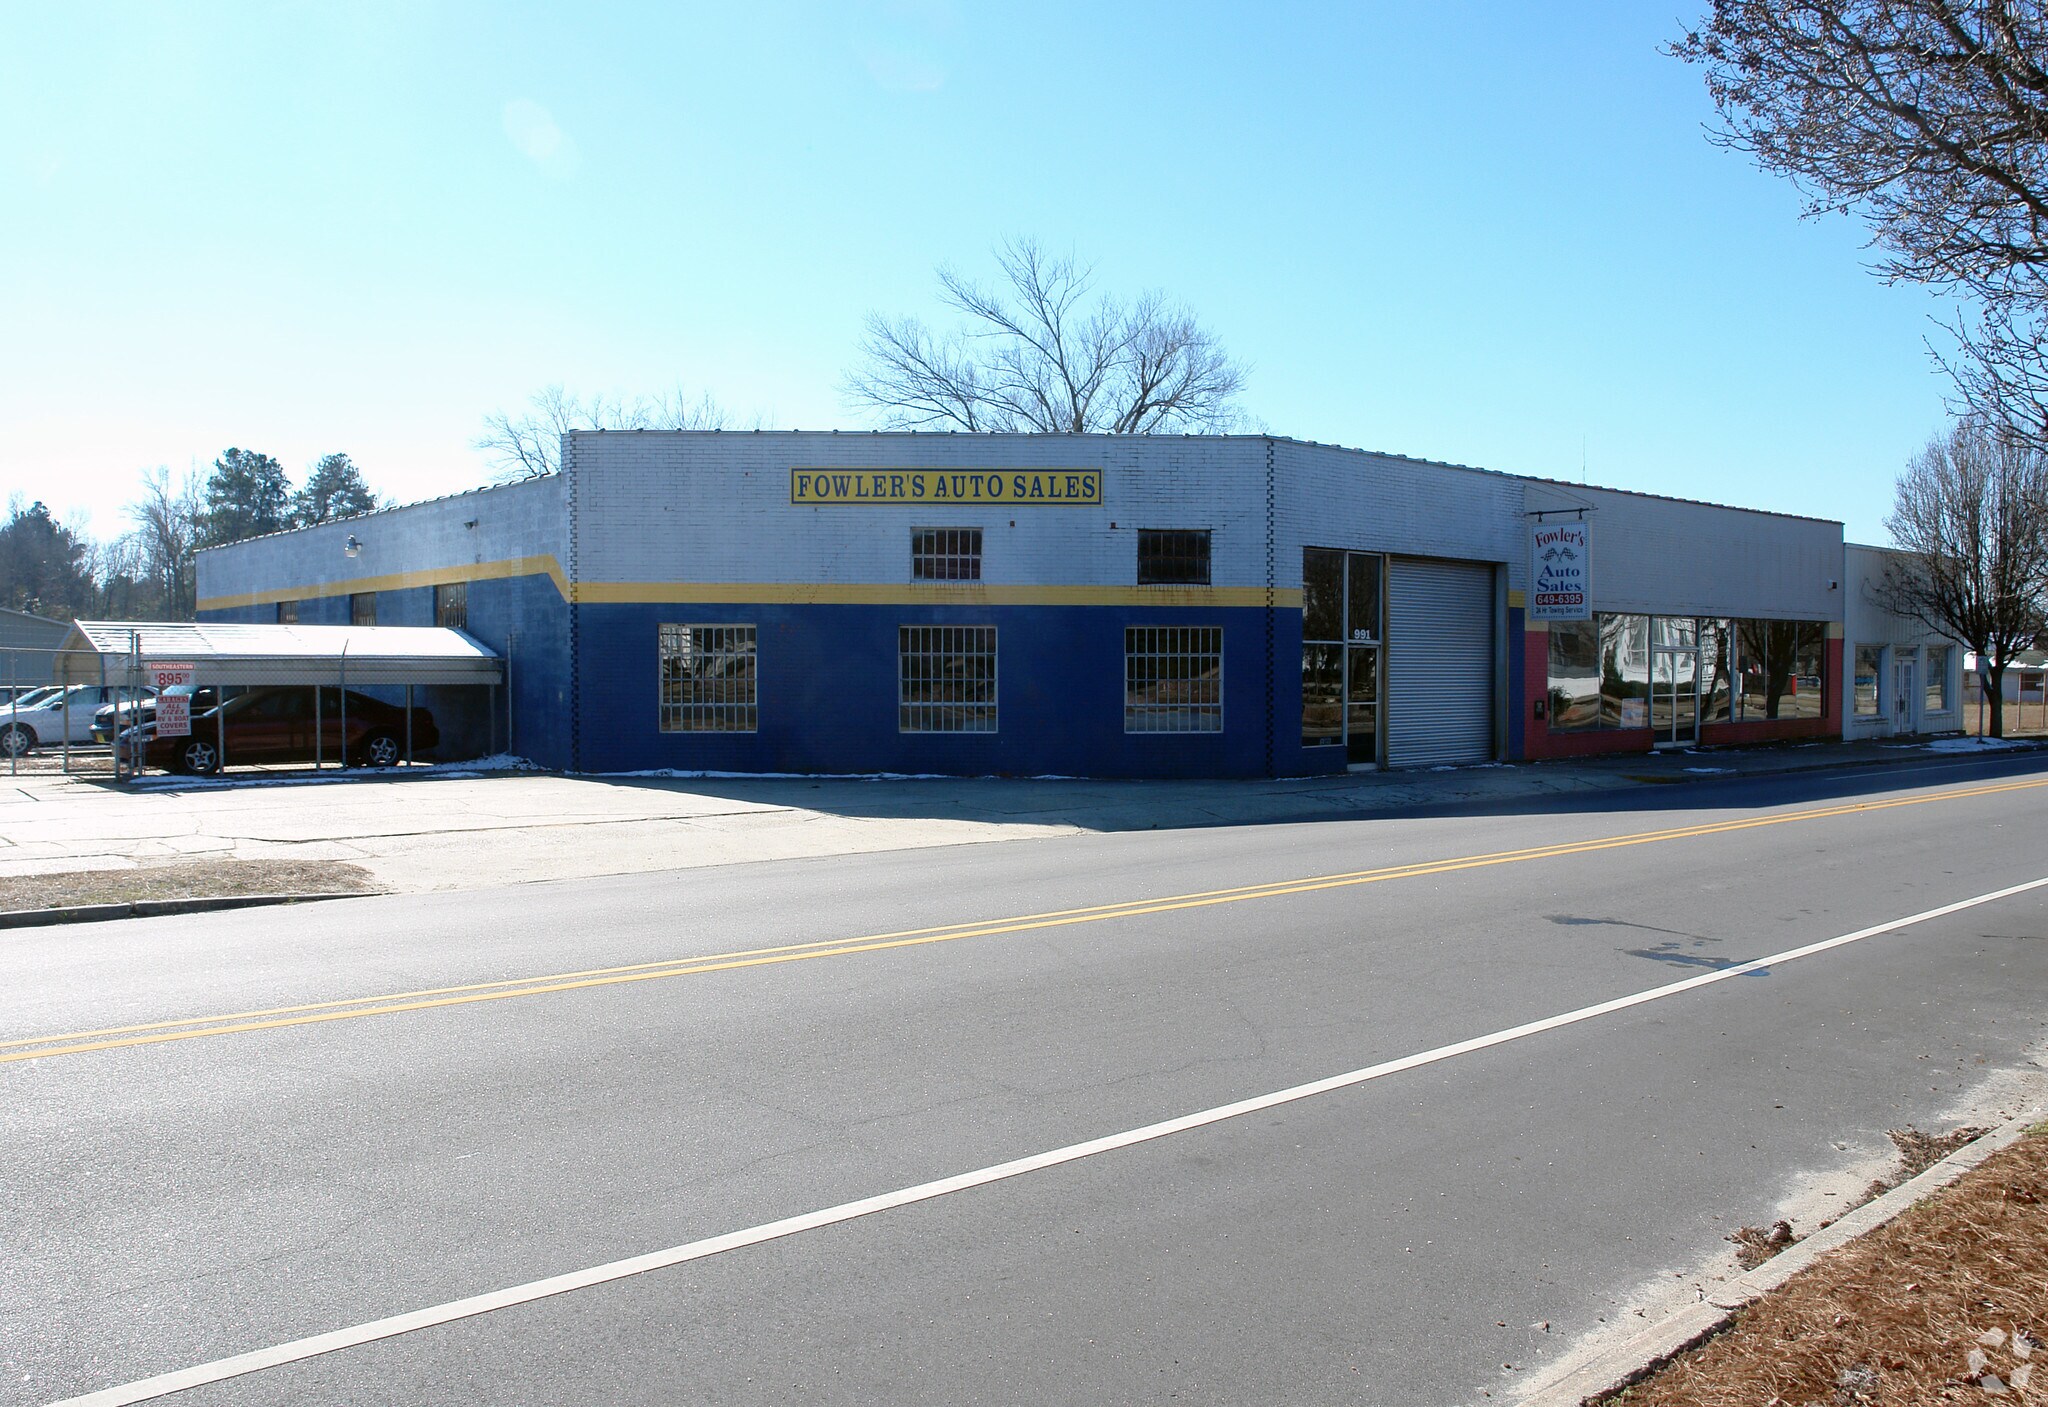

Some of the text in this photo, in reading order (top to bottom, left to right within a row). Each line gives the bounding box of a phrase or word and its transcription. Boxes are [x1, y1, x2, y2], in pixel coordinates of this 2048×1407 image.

[797, 475, 1096, 498] FOWLER'S AUTO SALES
[1535, 527, 1585, 548] Fowler's
[1539, 565, 1580, 577] Auto
[1537, 579, 1581, 592] Sales
[1537, 594, 1581, 603] 649-6395
[1549, 606, 1565, 615] Towing
[1566, 606, 1583, 614] Service
[1354, 629, 1371, 639] 991
